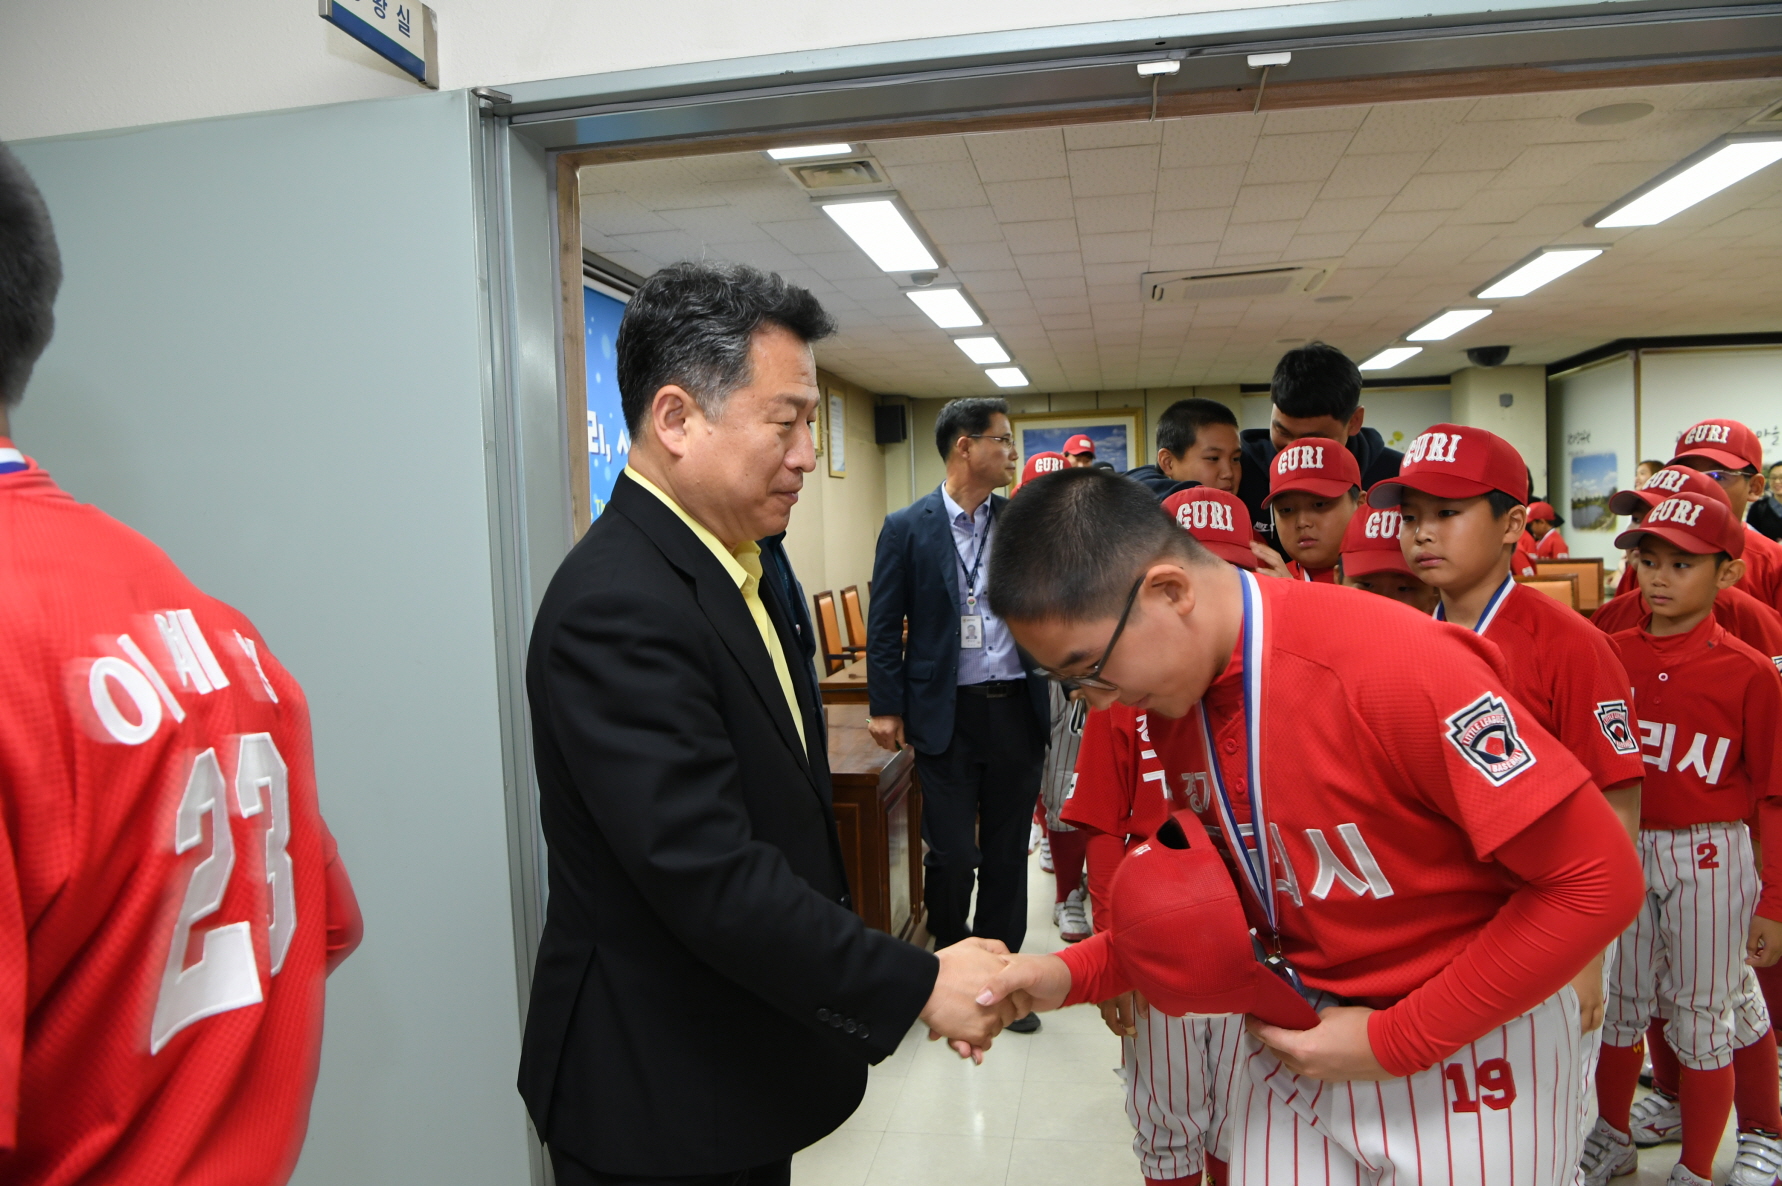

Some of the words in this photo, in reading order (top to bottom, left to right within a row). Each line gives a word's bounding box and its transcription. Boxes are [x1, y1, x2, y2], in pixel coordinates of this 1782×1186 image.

[1683, 425, 1731, 445] GURI
[1035, 457, 1064, 473] GURI
[1278, 446, 1324, 475] GURI
[1403, 433, 1462, 468] GURI
[1176, 500, 1234, 531] GURI
[1648, 499, 1704, 527] GURI
[1462, 724, 1482, 746] LITTLE
[1480, 714, 1506, 729] LEAGUE
[1697, 843, 1719, 870] 2
[151, 731, 297, 1055] 23
[1446, 1057, 1517, 1113] 19
